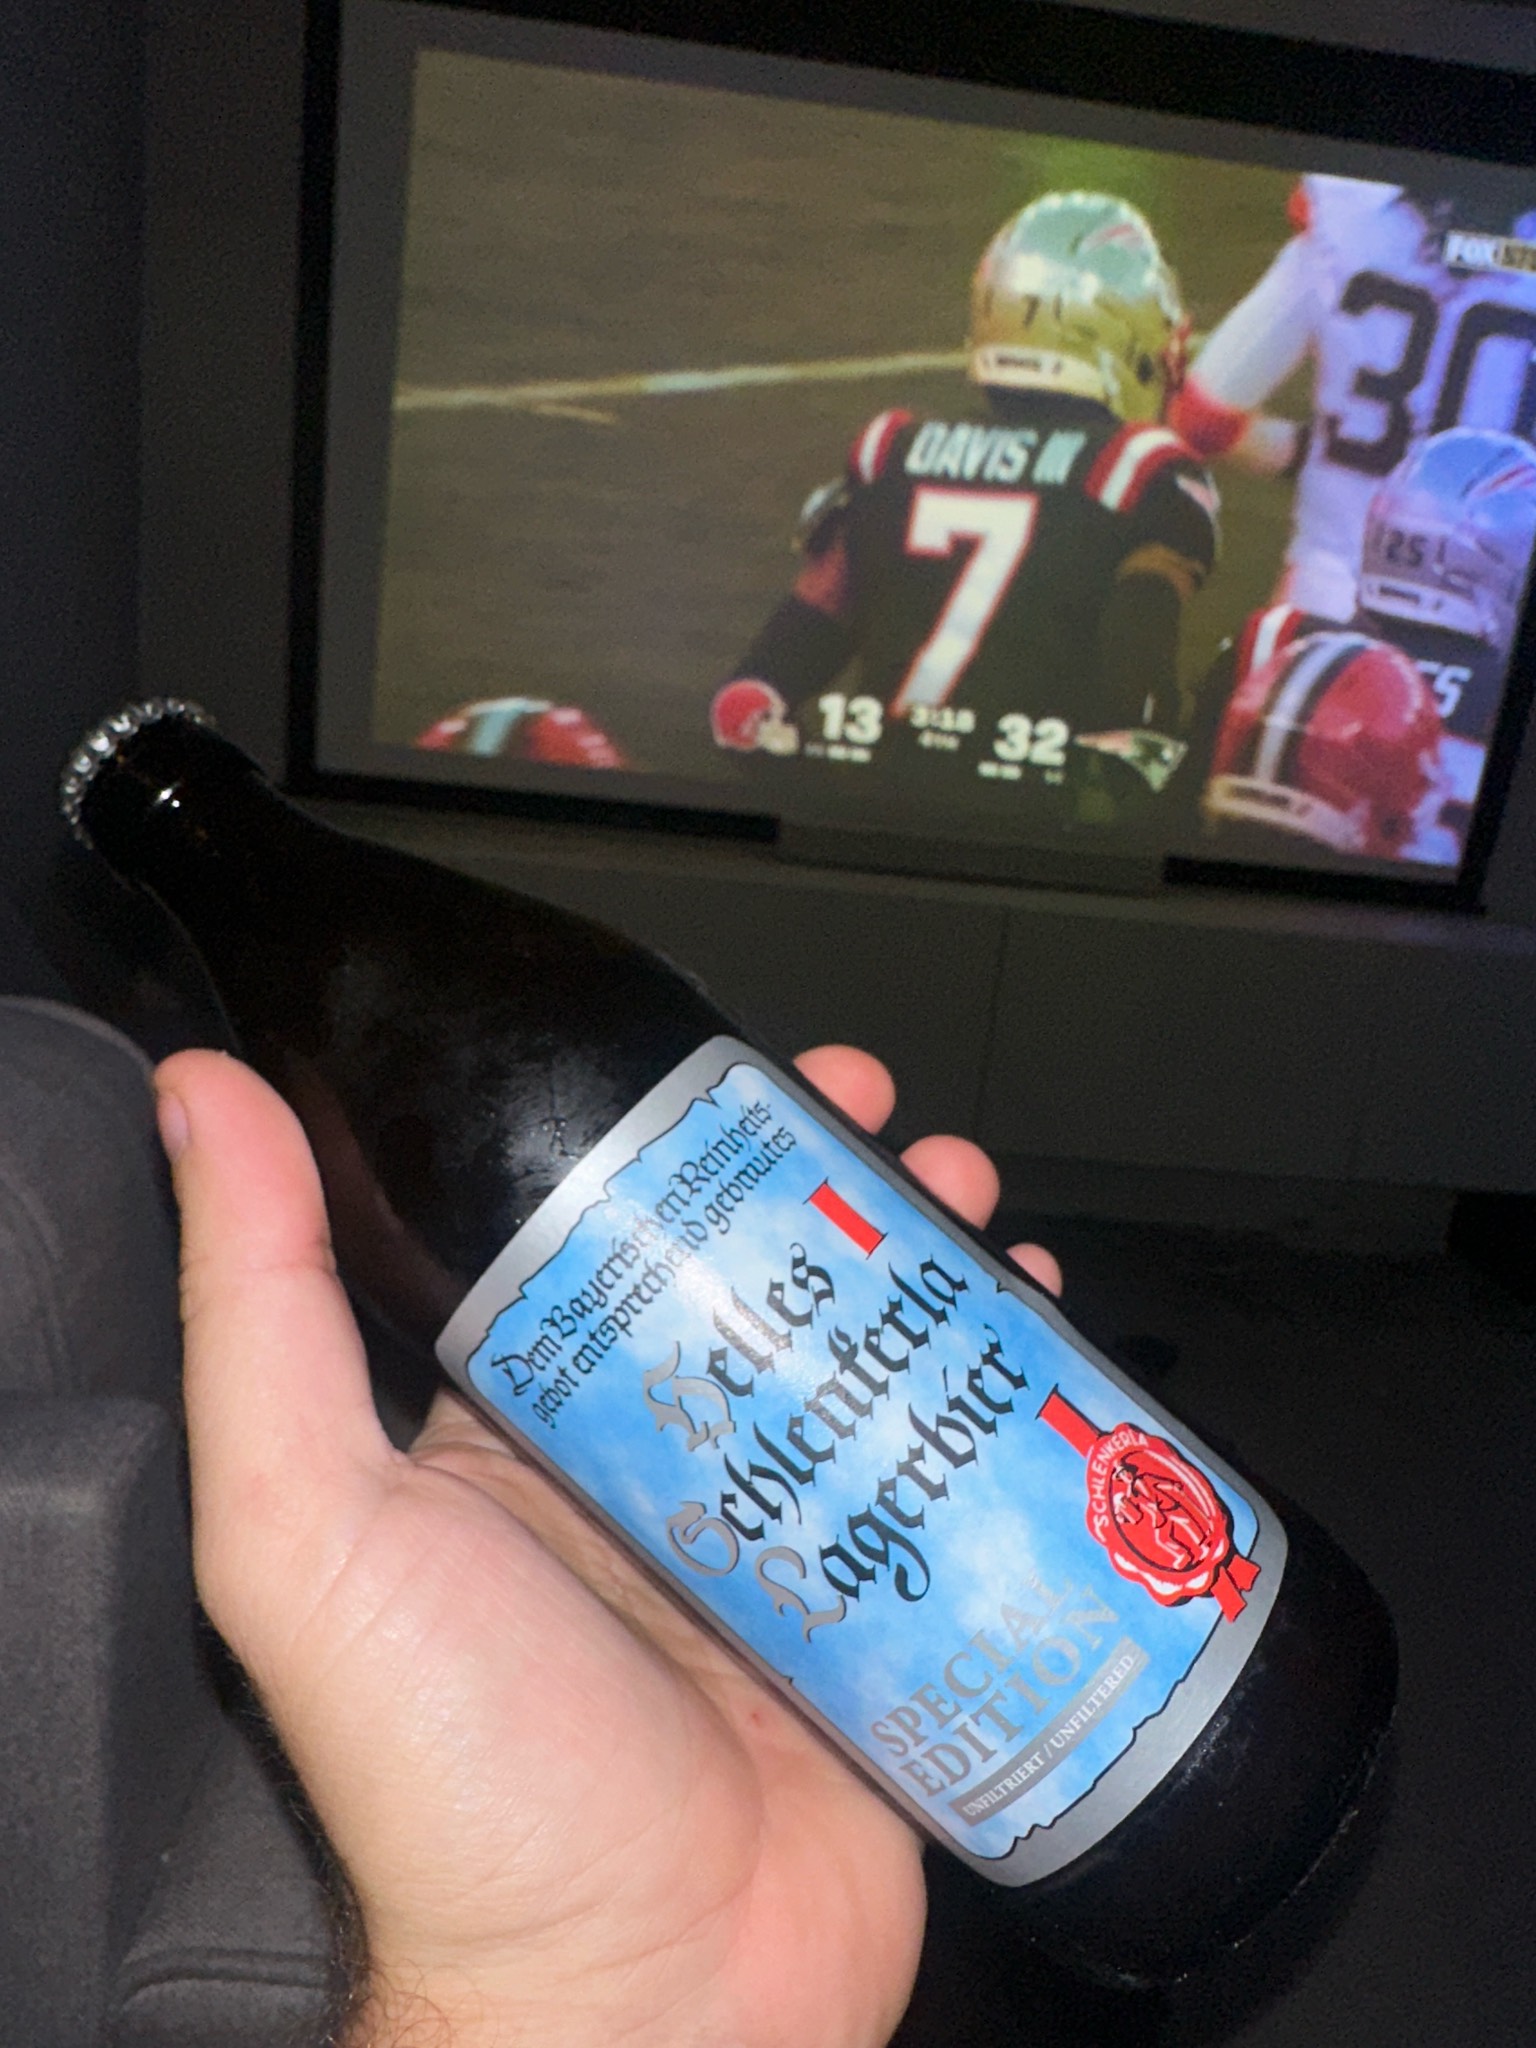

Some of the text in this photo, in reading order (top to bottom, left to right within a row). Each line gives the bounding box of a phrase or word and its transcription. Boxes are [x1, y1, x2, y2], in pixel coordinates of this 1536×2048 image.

[904, 421, 1038, 483] DAVIS
[892, 484, 1041, 718] 7
[818, 693, 884, 745] 13
[994, 713, 1069, 766] 32
[490, 1333, 563, 1397] Dem
[1091, 1429, 1149, 1528] SCHLENKERLA
[870, 1567, 1074, 1757] SPECIAL
[899, 1584, 1120, 1797] EDITION
[961, 1753, 1046, 1818] UNFILTRIERT
[1049, 1654, 1136, 1750] UNFILTERED
